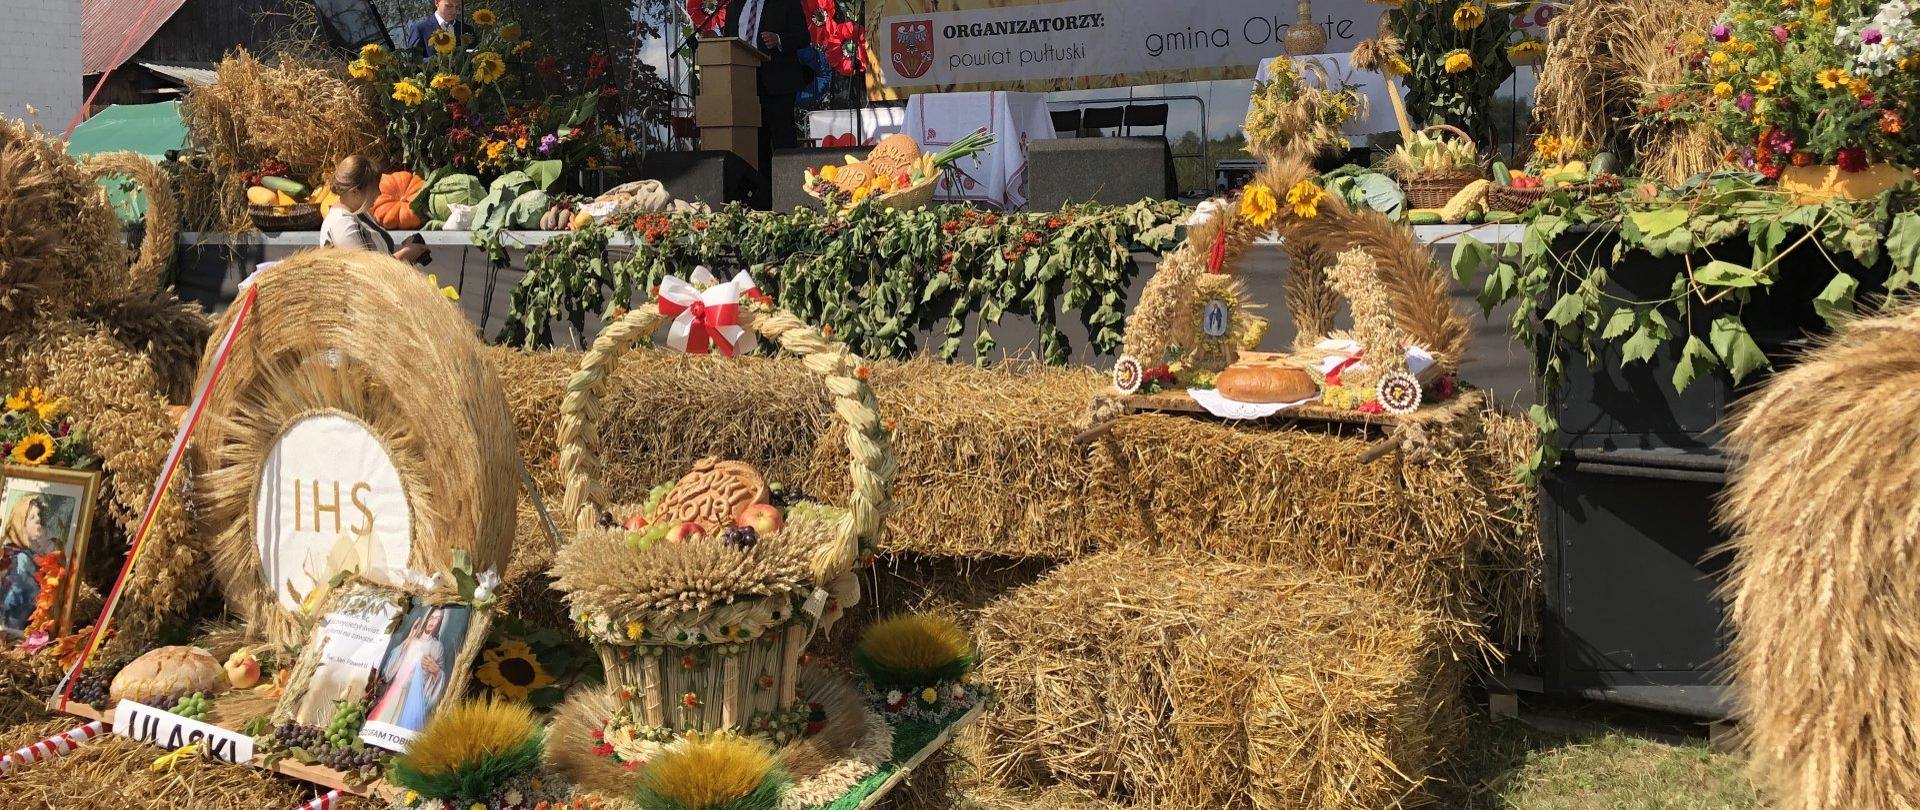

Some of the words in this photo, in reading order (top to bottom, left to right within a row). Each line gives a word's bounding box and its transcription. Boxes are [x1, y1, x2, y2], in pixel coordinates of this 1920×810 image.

[943, 13, 1105, 39] ORGANIZATORZY:
[1145, 26, 1230, 57] gmina
[1243, 14, 1354, 45] Obte
[949, 47, 1011, 71] powiat
[1019, 42, 1085, 67] pułtuski
[294, 478, 374, 537] IHS
